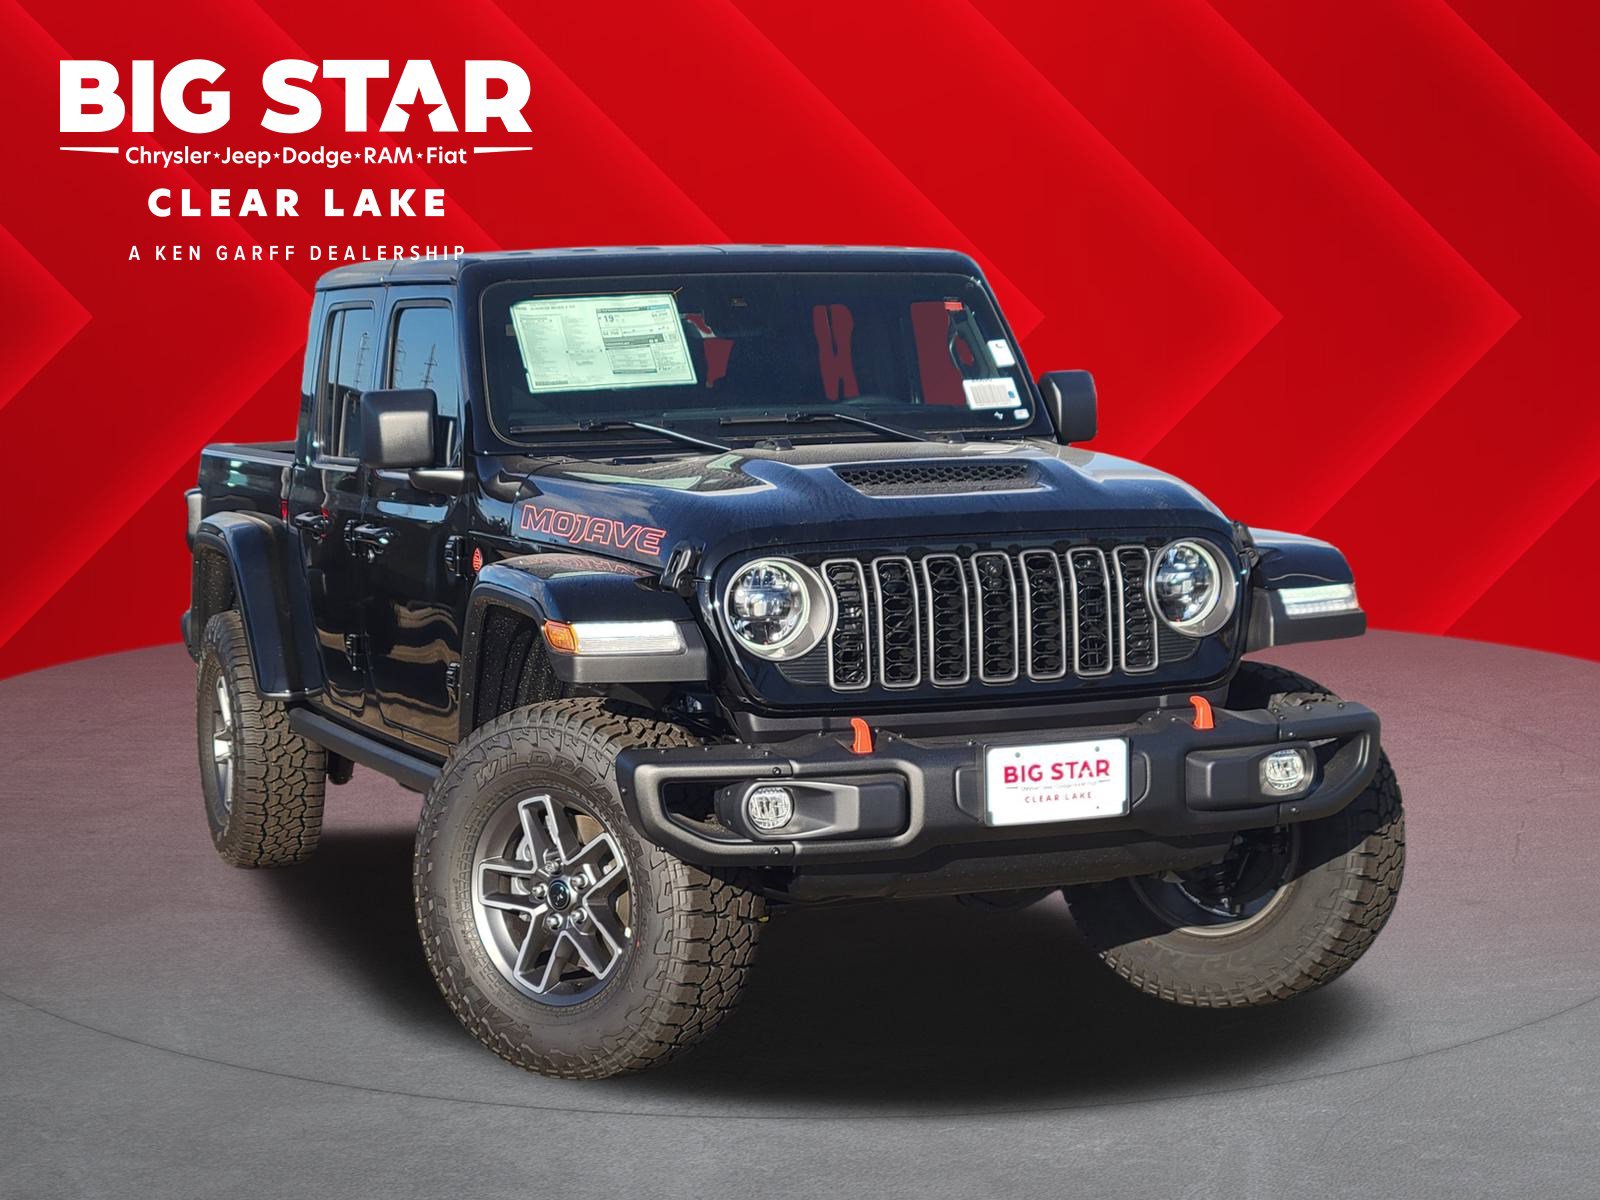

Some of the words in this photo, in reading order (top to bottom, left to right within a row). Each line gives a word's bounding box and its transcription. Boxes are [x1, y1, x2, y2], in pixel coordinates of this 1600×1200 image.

[521, 505, 666, 555] MOJAVE
[1003, 764, 1043, 785] BIG
[1051, 759, 1110, 781] STAR
[1024, 793, 1059, 804] CLEAR
[1064, 791, 1092, 801] LAKE
